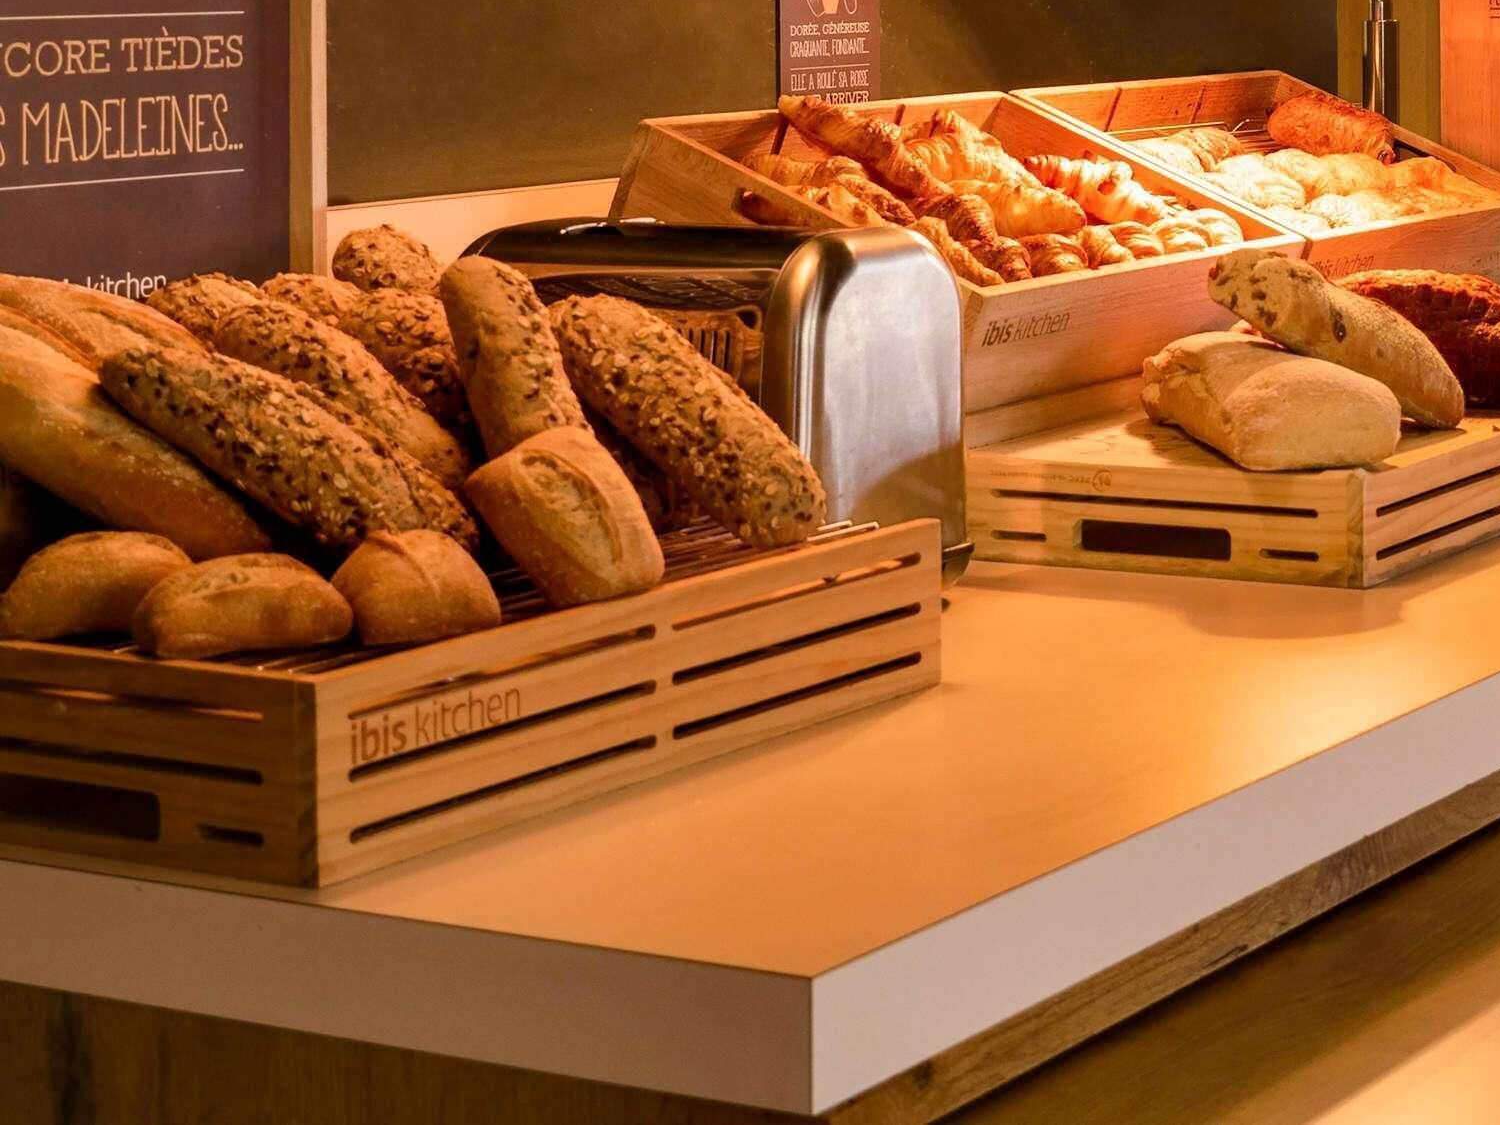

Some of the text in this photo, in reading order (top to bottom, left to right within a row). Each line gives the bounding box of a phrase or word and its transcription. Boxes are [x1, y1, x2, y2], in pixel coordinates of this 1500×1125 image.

[0, 26, 244, 78] CORE TIÈDES
[22, 93, 244, 166] MADELEINES...
[982, 312, 1071, 348] ibis kitchen
[351, 686, 522, 766] ibis kitchen
